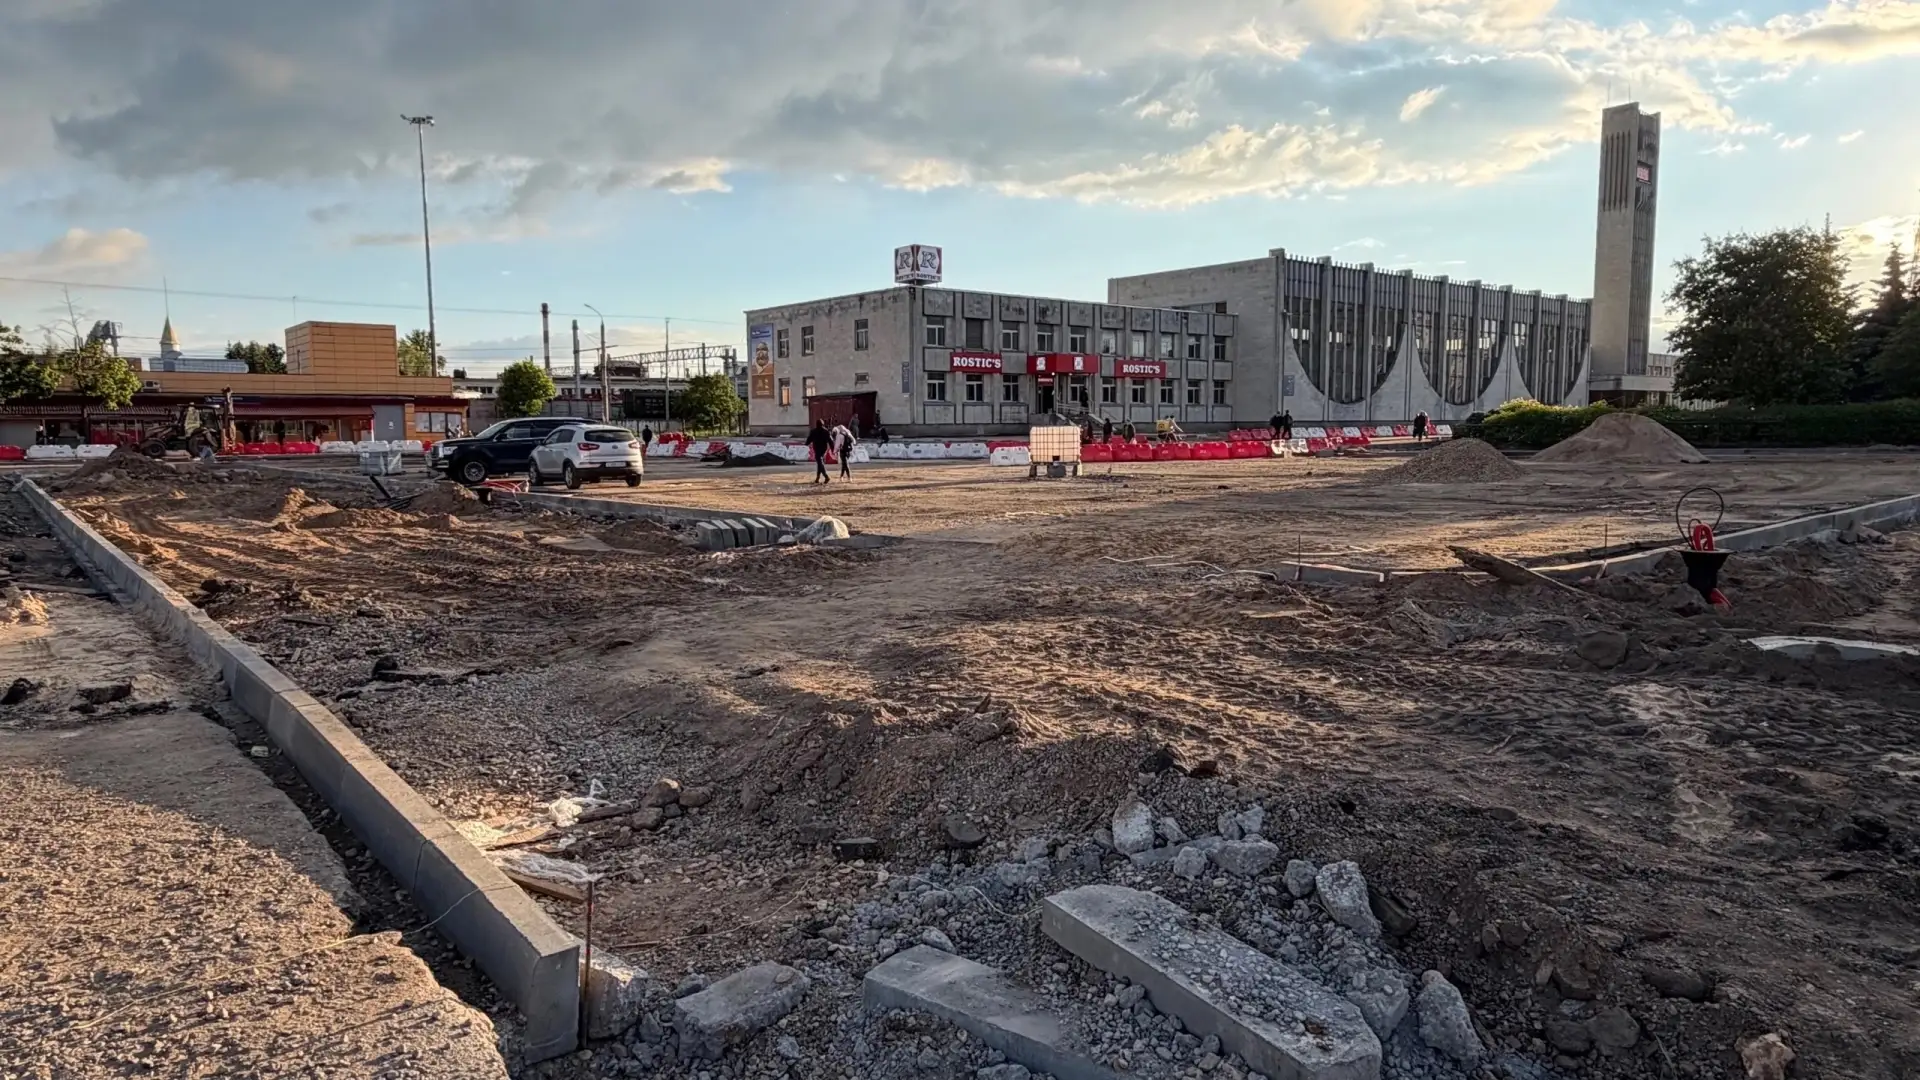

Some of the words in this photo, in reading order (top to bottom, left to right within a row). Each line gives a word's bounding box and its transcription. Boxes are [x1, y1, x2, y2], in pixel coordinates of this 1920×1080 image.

[920, 251, 936, 269] R
[953, 357, 1001, 368] ROSTIC'S
[1123, 364, 1160, 374] ROSTIC'S
